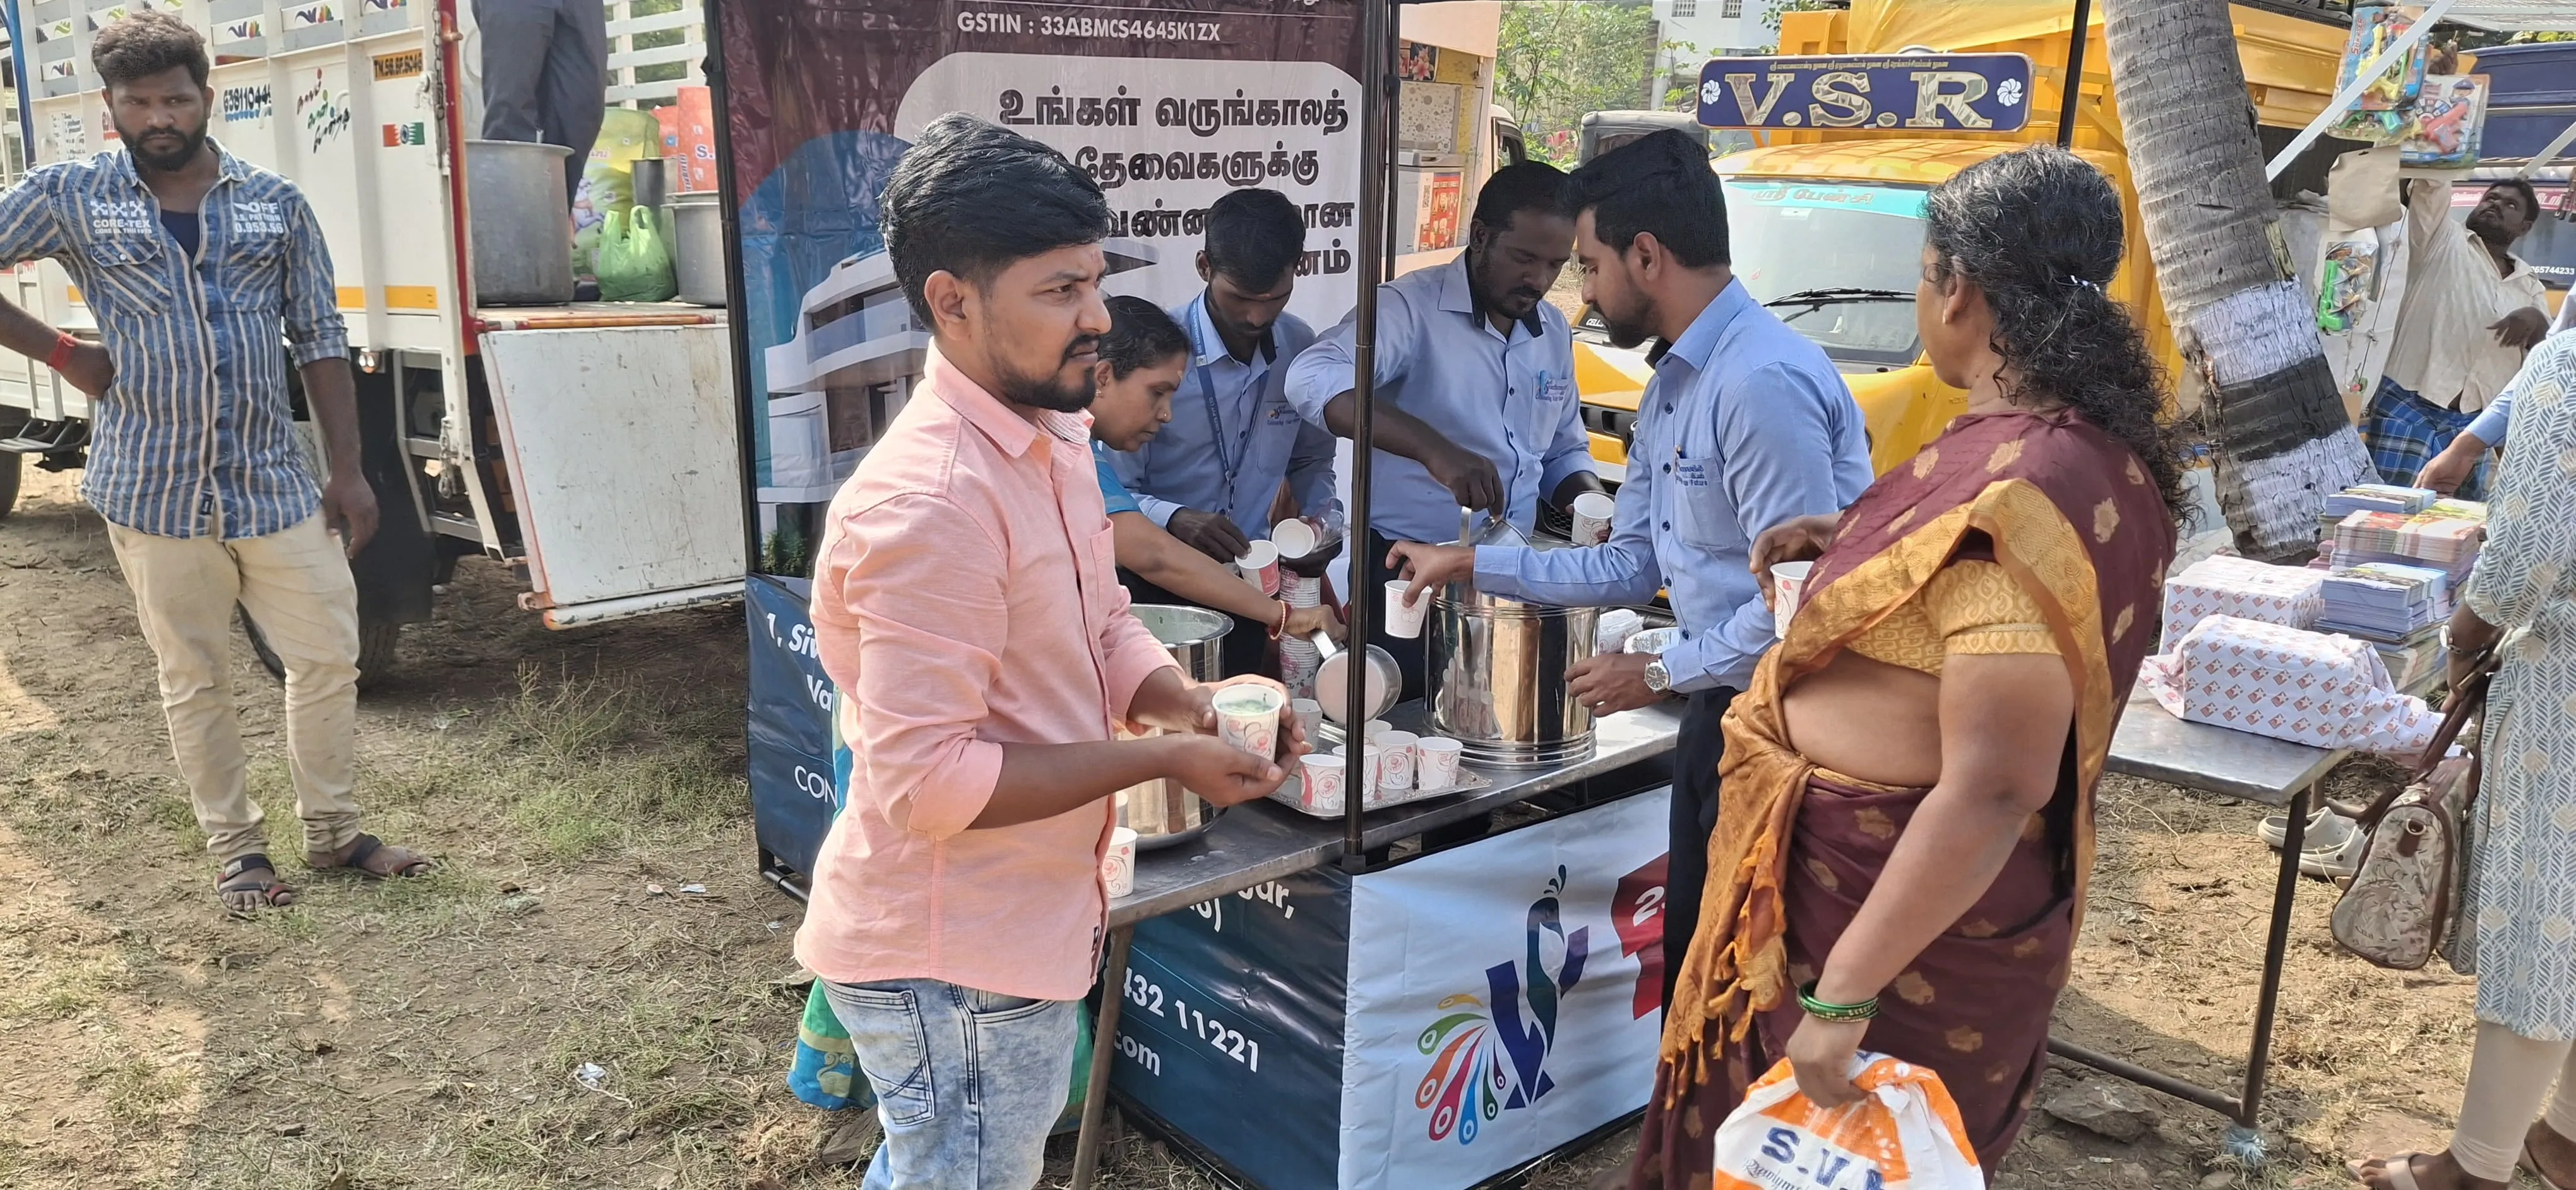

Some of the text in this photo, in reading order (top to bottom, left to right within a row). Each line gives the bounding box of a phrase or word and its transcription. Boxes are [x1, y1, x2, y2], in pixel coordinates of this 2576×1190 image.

[957, 11, 1021, 33] GSTIN
[1041, 16, 1220, 42] 33ABMCS4645K1ZX
[999, 84, 1349, 136] உங்கள் வருங்காலத்
[1725, 71, 1993, 129] V.S.R
[1075, 140, 1319, 191] தேவைகளுக்கு
[93, 219, 152, 228] CORE-TEX
[794, 765, 838, 809] CON
[1175, 1000, 1259, 1073] 11221
